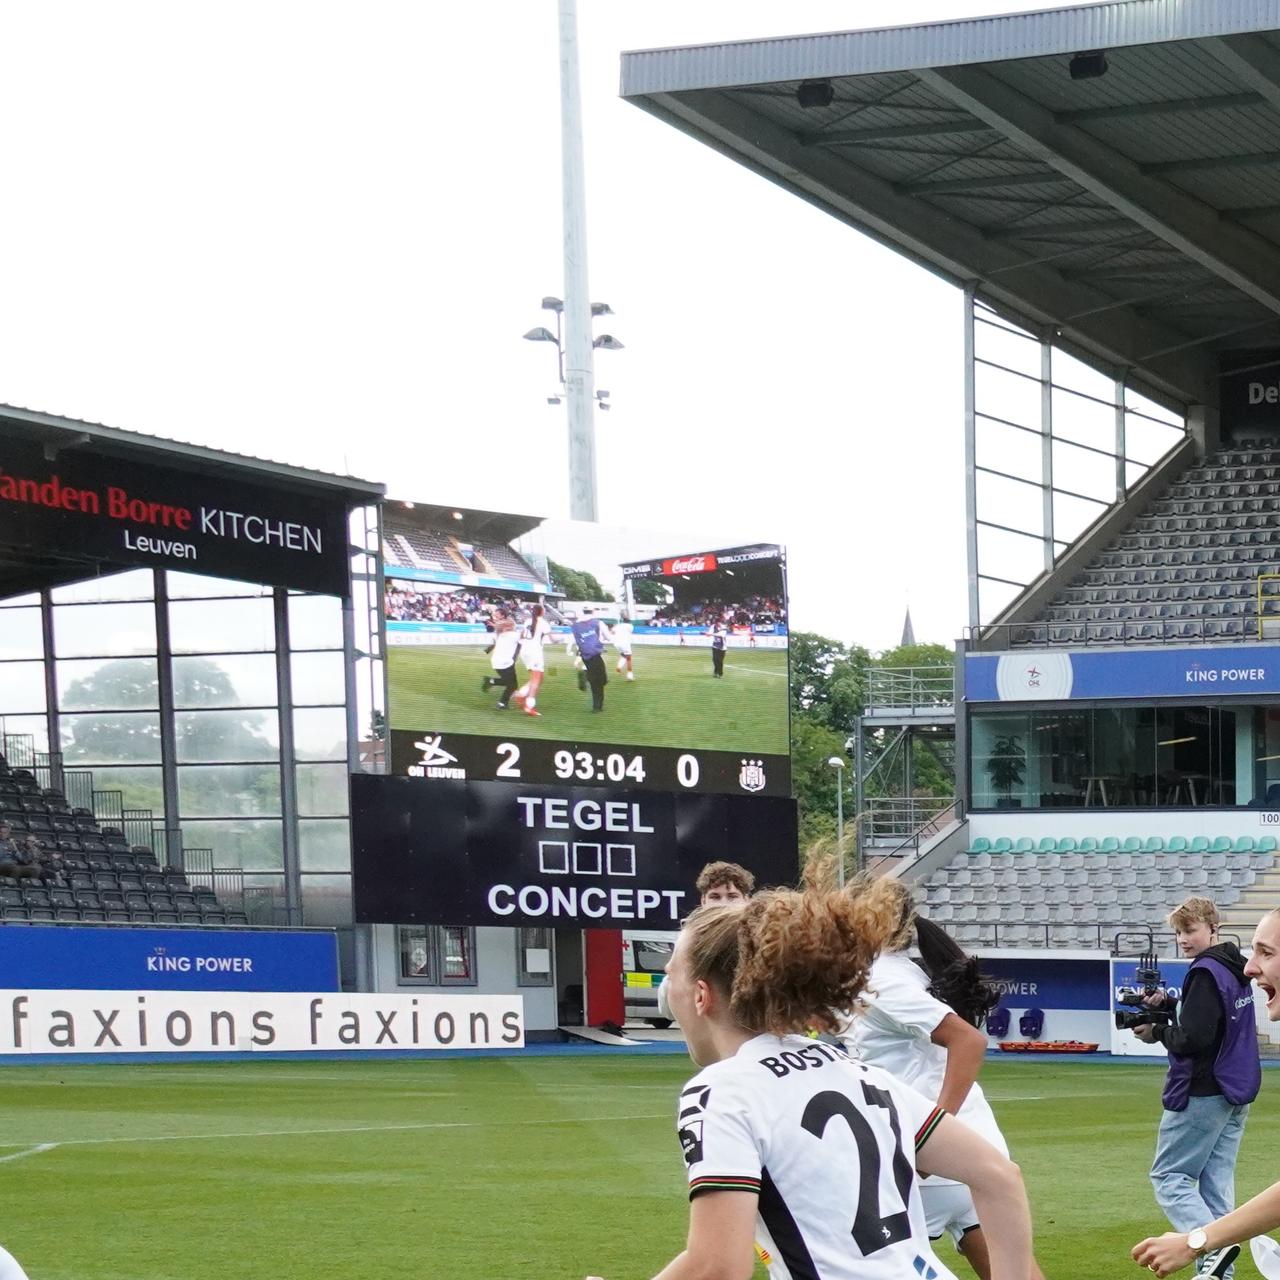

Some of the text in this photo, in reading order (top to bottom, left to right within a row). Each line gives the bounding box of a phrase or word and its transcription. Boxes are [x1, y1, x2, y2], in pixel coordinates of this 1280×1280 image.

[0, 466, 321, 553] anden Borre KITCHEN
[124, 530, 196, 559] Leuven
[1186, 668, 1265, 682] KING POWER
[408, 766, 466, 779] OH LEUVEN
[496, 743, 521, 777] 2
[554, 750, 646, 783] 93:04
[677, 754, 699, 788] 0
[517, 797, 655, 833] TEGEL
[1262, 813, 1280, 823] 100
[488, 884, 686, 919] CONCEPT
[147, 956, 253, 973] KING POWER
[12, 996, 522, 1047] faxions faxions
